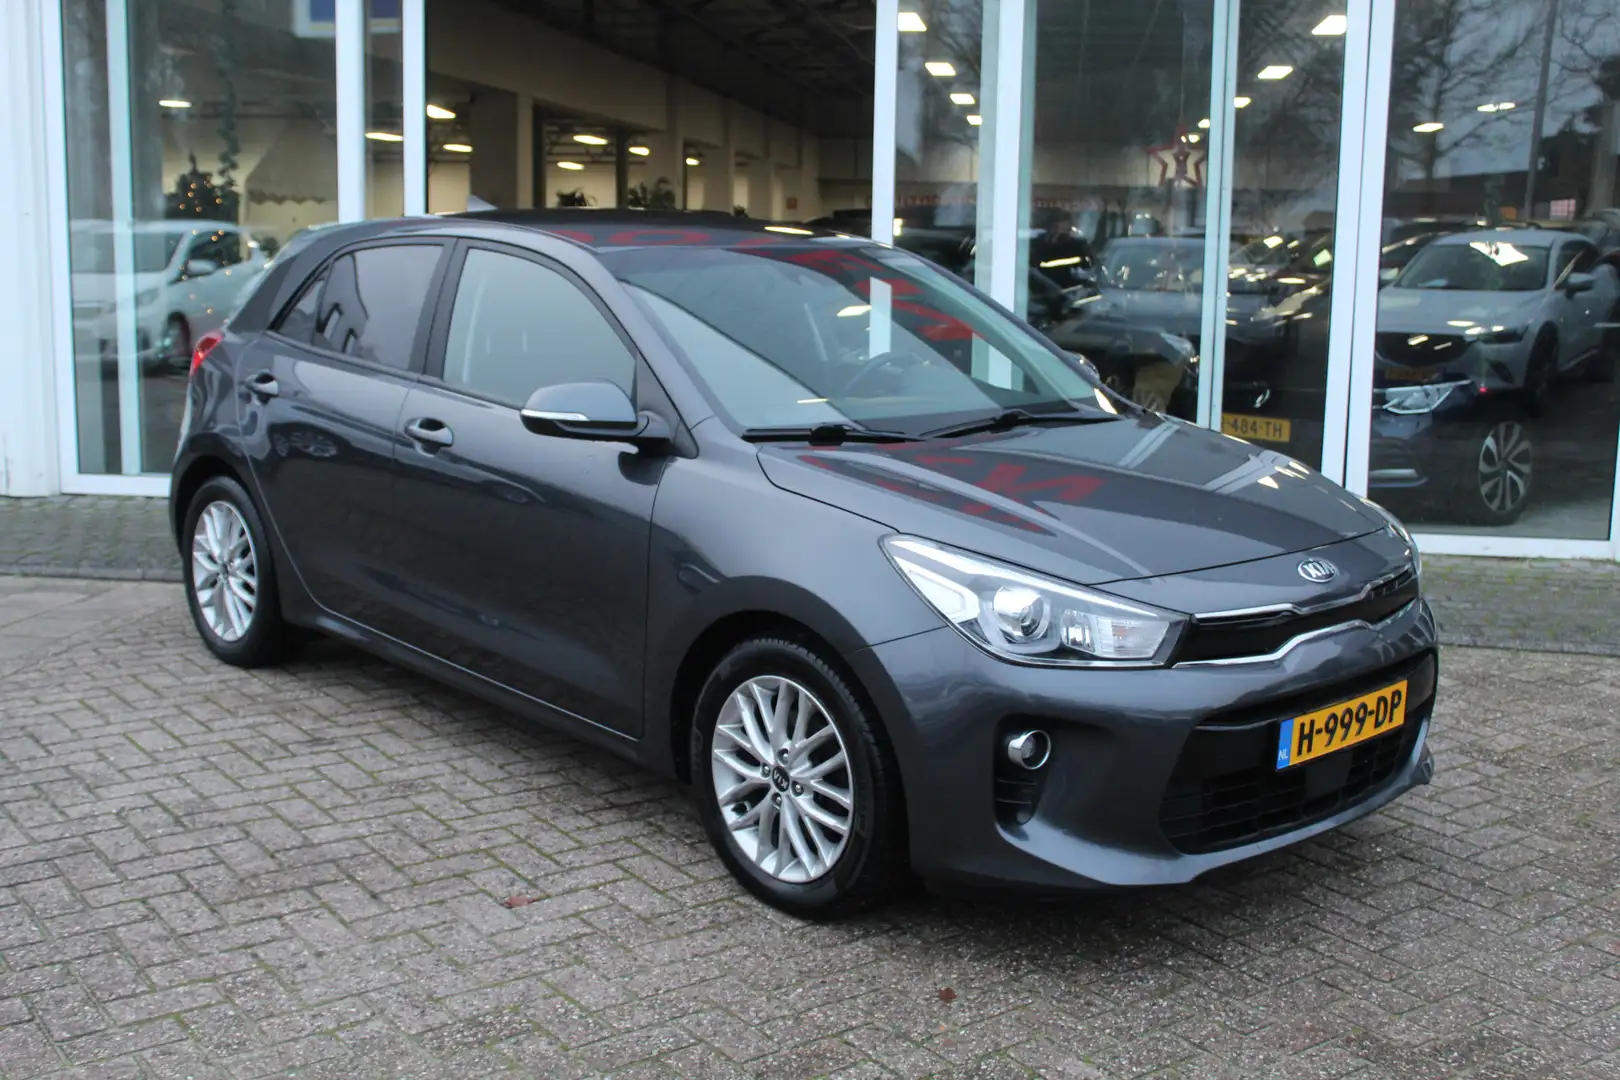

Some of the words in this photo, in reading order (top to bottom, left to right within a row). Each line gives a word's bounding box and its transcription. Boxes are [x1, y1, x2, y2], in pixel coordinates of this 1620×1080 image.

[1302, 560, 1335, 578] KIA
[1297, 689, 1402, 756] H-999-DP
[1278, 748, 1289, 761] NL
[773, 770, 788, 790] KIA
